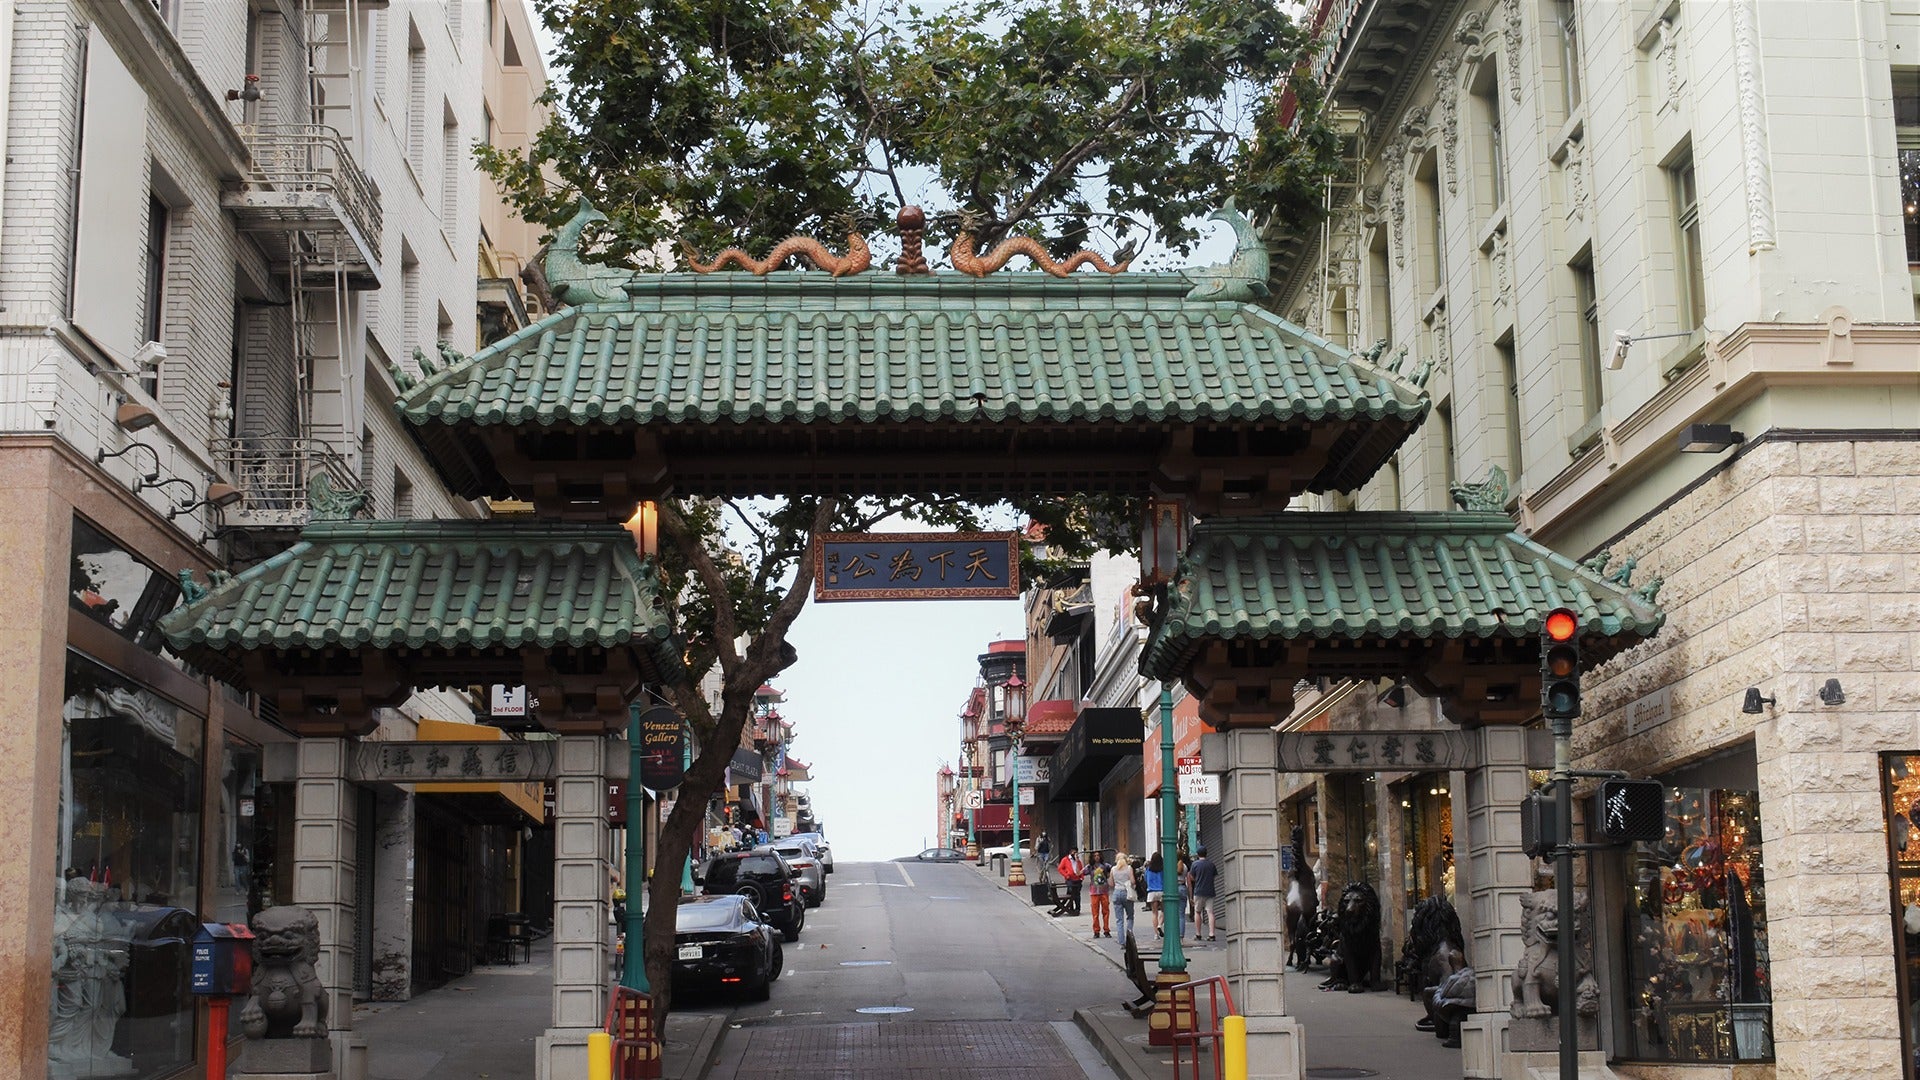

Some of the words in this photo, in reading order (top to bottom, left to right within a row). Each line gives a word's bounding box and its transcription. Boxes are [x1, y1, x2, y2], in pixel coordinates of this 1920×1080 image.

[643, 721, 680, 731] Venezia
[645, 732, 678, 745] Gallery
[1178, 765, 1190, 774] NO
